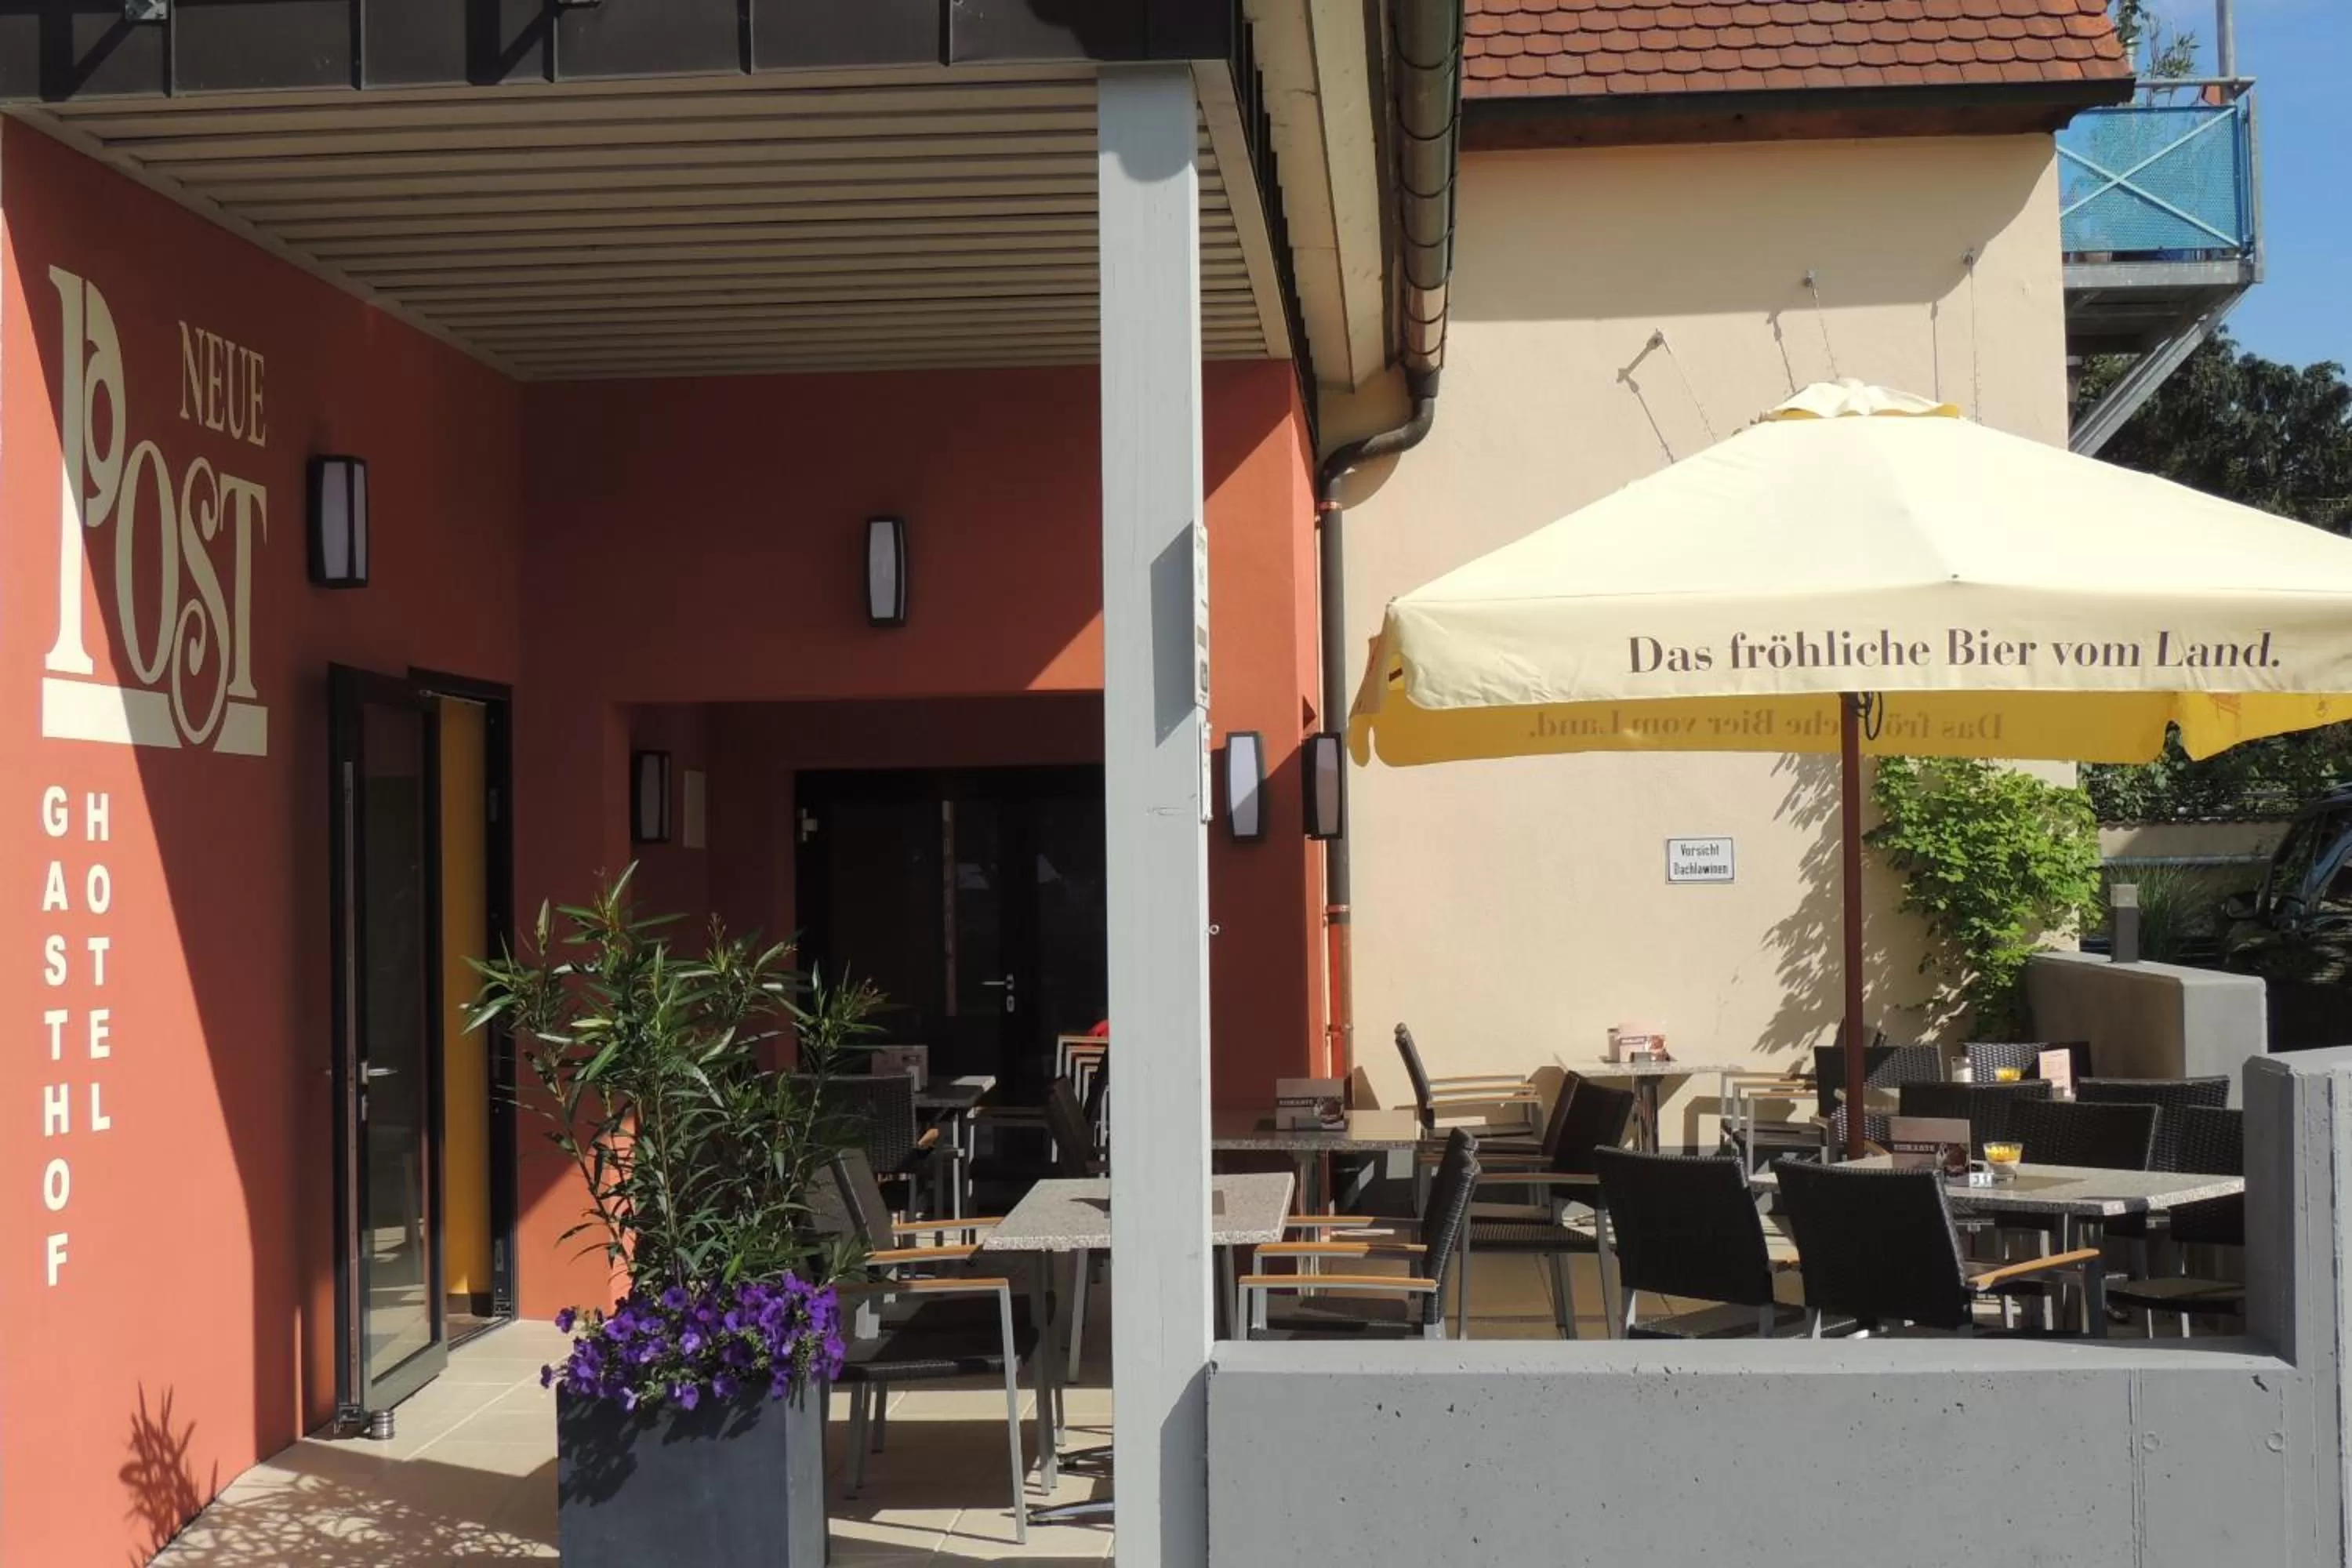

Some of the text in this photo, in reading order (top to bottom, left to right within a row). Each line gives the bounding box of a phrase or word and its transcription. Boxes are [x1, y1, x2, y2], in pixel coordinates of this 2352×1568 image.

[178, 320, 267, 448] NEUE
[44, 263, 267, 745] POST
[1627, 628, 2281, 673] Das fröhliche Bier vom Land.
[1673, 862, 1728, 876] Dachlawinen
[1680, 843, 1719, 857] Vorsicht
[86, 792, 111, 1131] HOTEL
[42, 785, 71, 1287] GASTHOF
